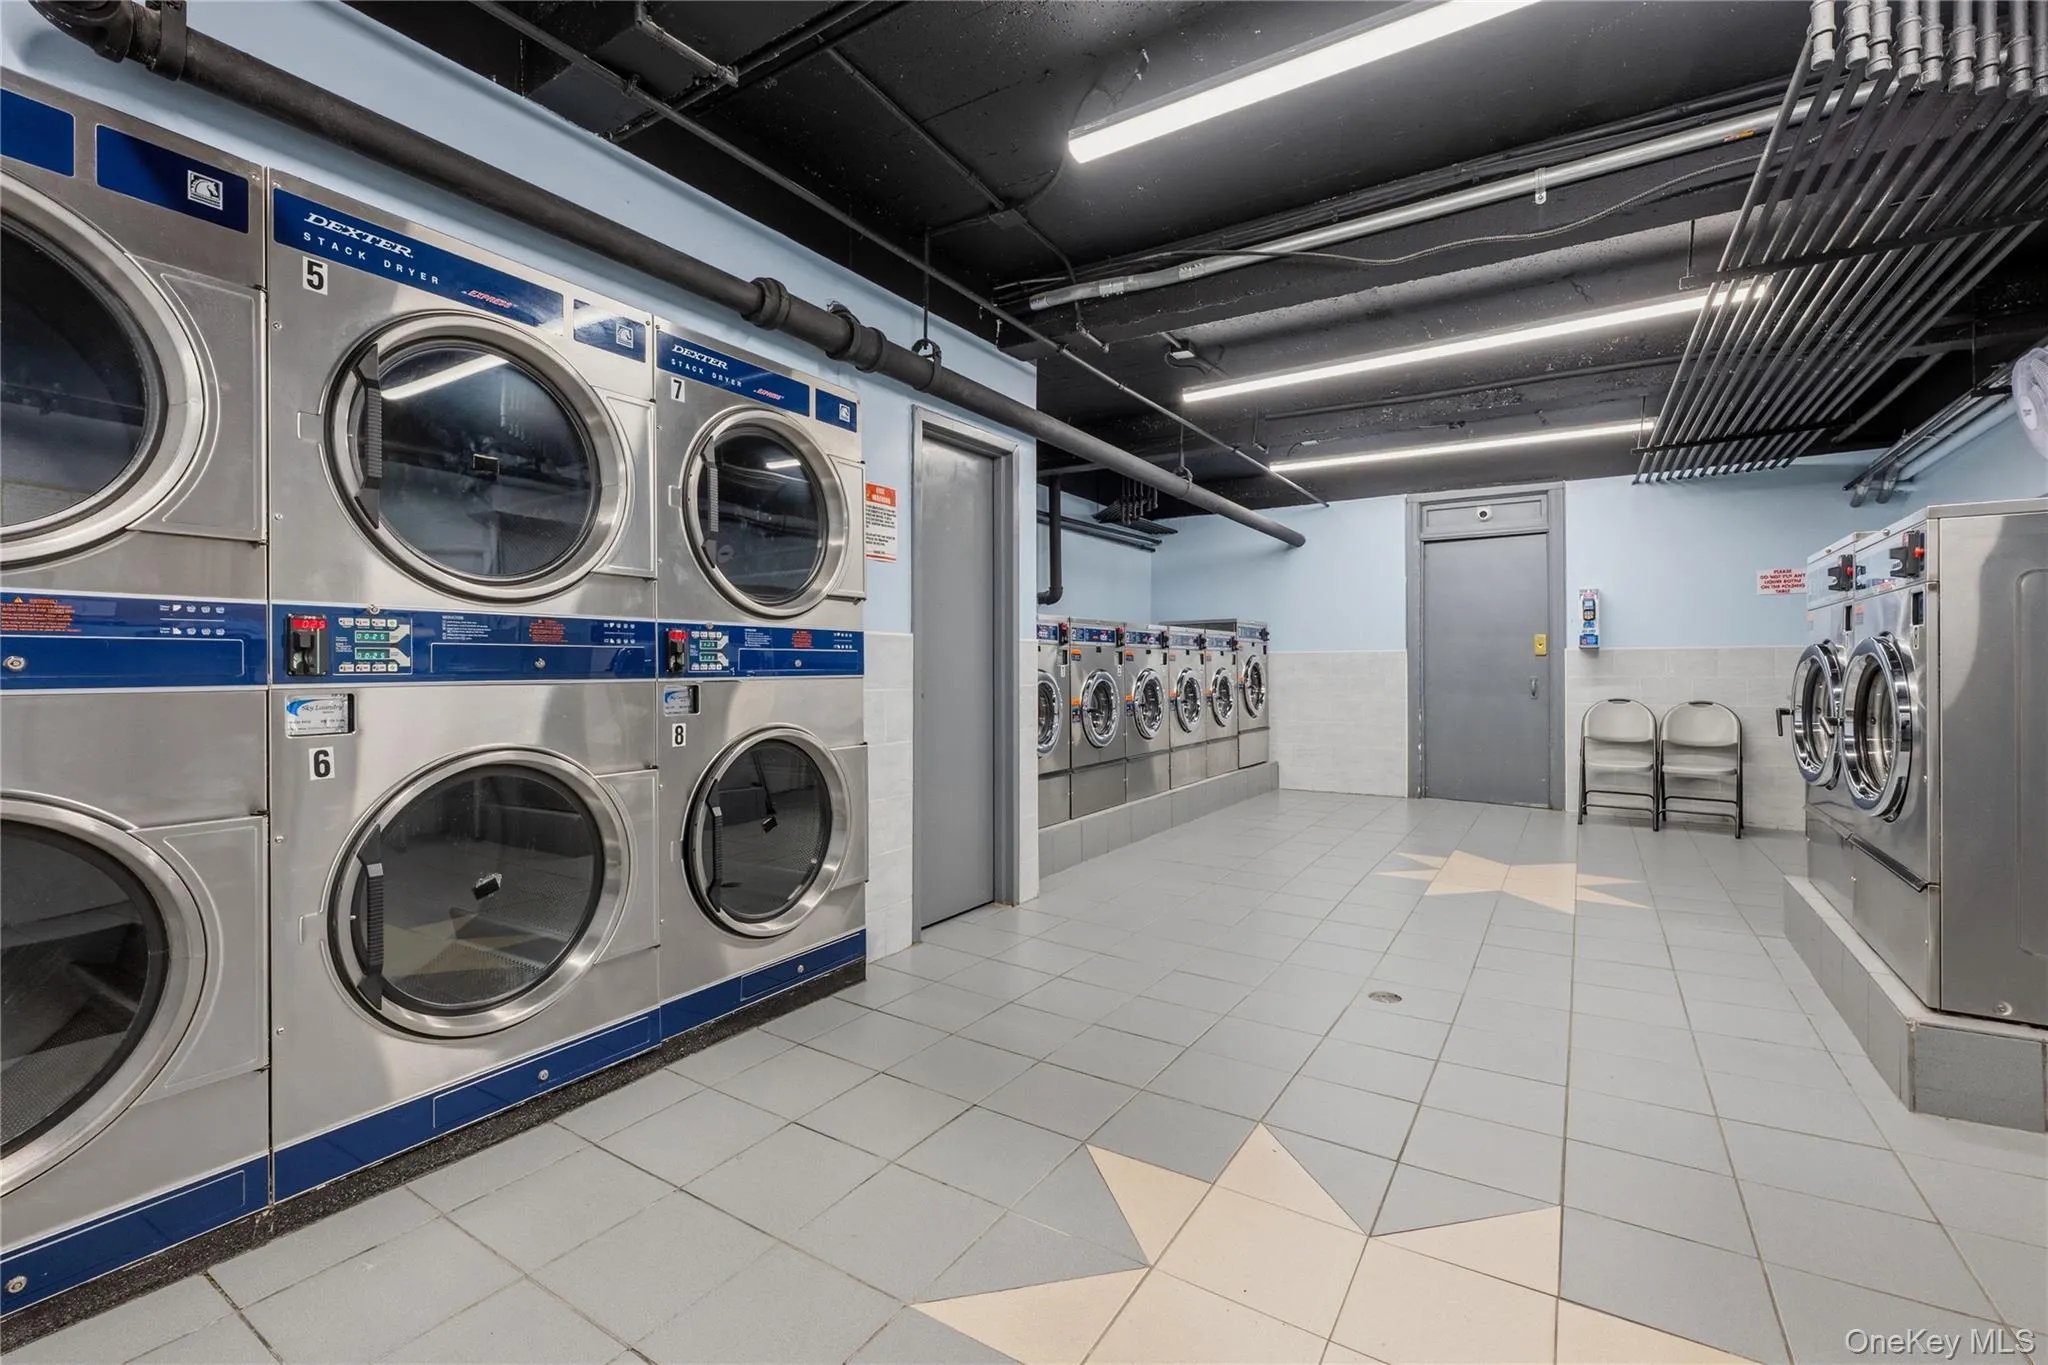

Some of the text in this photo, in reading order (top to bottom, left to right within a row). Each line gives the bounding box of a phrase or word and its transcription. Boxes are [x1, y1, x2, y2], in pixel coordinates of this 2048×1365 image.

[304, 212, 414, 259] DEXTER
[303, 231, 440, 286] STACK DRYER
[306, 259, 324, 291] 5
[671, 344, 728, 371] DEXTER
[671, 358, 743, 388] STACK DRYER
[673, 378, 682, 400] 7
[675, 725, 685, 745] 8
[313, 749, 331, 778] 6
